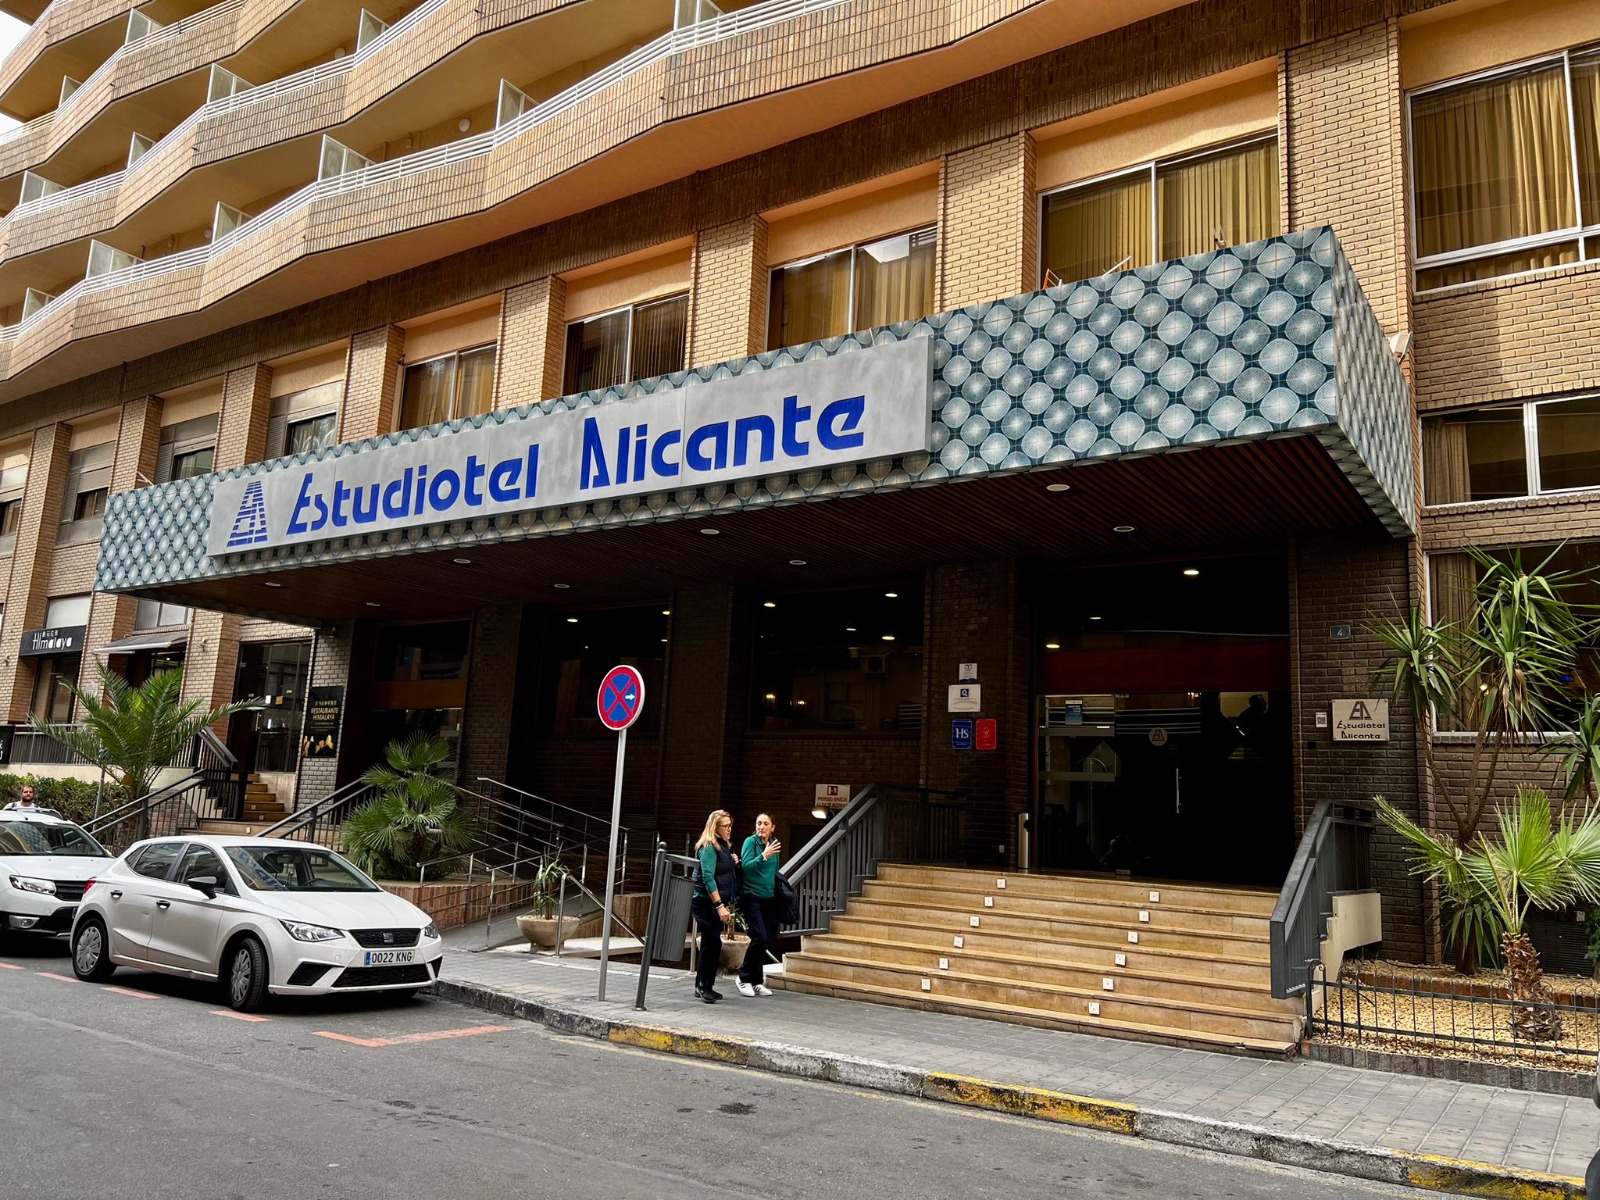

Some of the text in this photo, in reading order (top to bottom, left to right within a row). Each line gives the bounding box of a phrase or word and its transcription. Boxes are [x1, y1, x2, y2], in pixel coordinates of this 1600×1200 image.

[286, 395, 865, 535] Estudiotel Alicante
[1337, 628, 1343, 636] 4
[33, 632, 72, 650] Himalaya
[1336, 720, 1386, 729] Estudiotel
[955, 728, 969, 739] HS
[1341, 730, 1381, 739] Alicante
[372, 951, 412, 963] 0022 KNG
